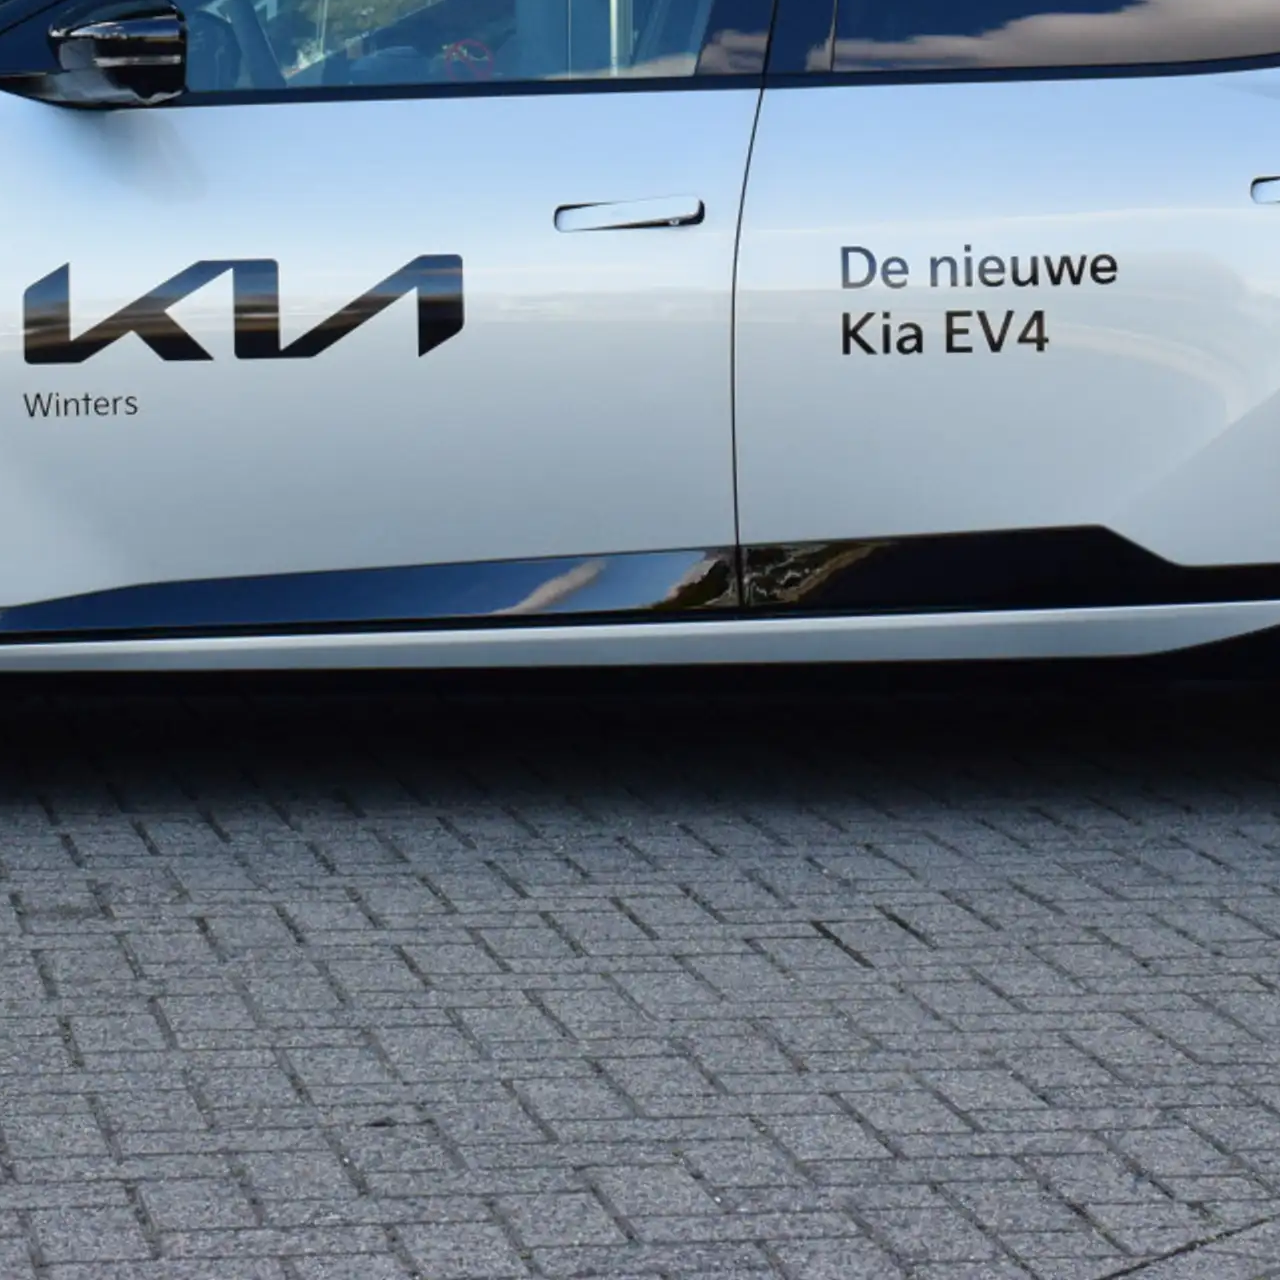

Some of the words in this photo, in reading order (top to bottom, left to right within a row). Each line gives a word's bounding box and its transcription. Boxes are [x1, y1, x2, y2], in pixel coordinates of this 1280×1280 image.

[840, 245, 910, 289] De
[929, 244, 1118, 288] nieuwe
[23, 254, 465, 365] KIA
[841, 311, 925, 355] Kia
[944, 310, 1049, 354] EV4
[23, 391, 138, 418] Winters
